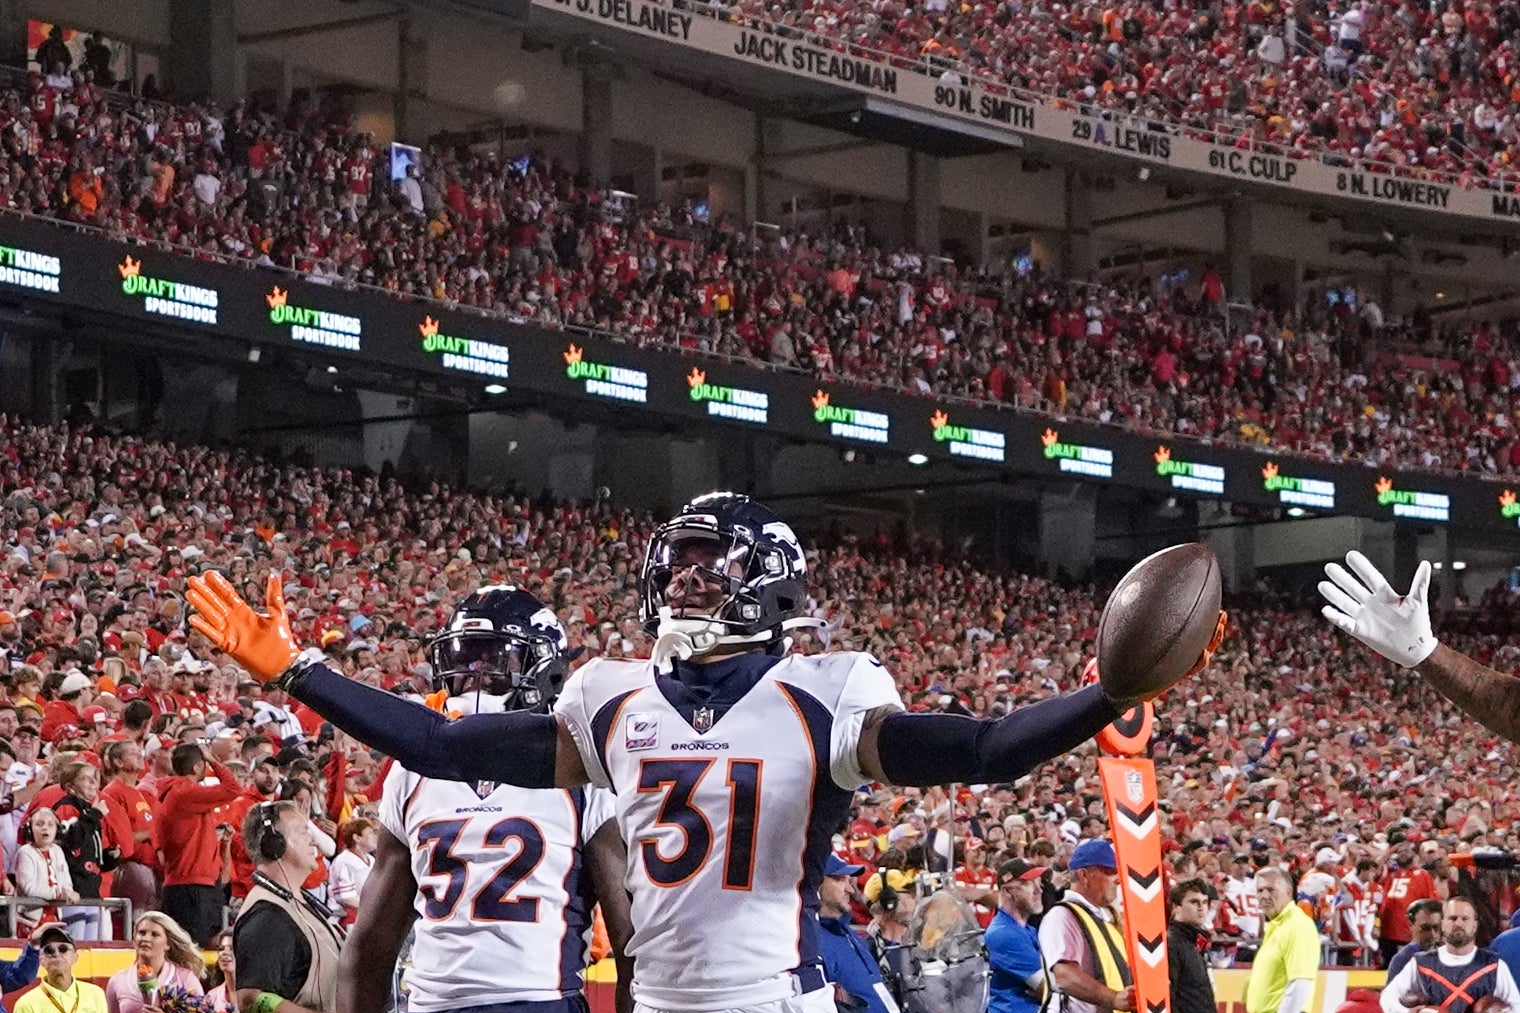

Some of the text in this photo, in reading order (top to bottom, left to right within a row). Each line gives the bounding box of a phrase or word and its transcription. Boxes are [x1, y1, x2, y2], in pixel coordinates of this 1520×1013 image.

[599, 0, 692, 40] DELANEY
[734, 31, 897, 94] JACK STEADMAN
[935, 86, 1035, 129] 90 N. SMITH
[1114, 127, 1171, 159] LEWIS
[1209, 150, 1297, 182] 61 C. CULP
[1350, 174, 1368, 195] N.
[1373, 177, 1450, 207] LOWERY
[123, 273, 218, 308] DRAFTKINGS
[145, 297, 217, 324] SPORTSBOOK
[271, 304, 361, 334] DRAFTKINGS
[291, 325, 360, 351] SPORTSBOOK
[423, 333, 509, 362] DRAFTKINGS
[443, 353, 509, 378] SPORTSBOOK
[567, 360, 648, 387] DRAFTKINGS
[586, 379, 647, 402] SPORTSBOOK
[690, 383, 768, 409] DRAFTKINGS
[708, 401, 768, 423] SPORTSBOOK
[815, 405, 889, 429] DRAFTKINGS
[831, 422, 888, 443] SPORTSBOOK
[934, 425, 1006, 448] DRAFTKINGS
[950, 440, 1005, 462] SPORTSBOOK
[1044, 442, 1114, 465] DRAFTKINGS
[1060, 458, 1113, 477] SPORTSBOOK
[1157, 460, 1225, 481] DRAFTKINGS
[1171, 474, 1224, 494] SPORTSBOOK
[1265, 475, 1335, 496] DRAFTKINGS
[1279, 490, 1334, 508] SPORTSBOOK
[1378, 490, 1450, 508] DRAFTKINGS
[1393, 503, 1449, 521] SPORTSBOOK
[671, 742, 730, 751] BRONCOS
[455, 806, 503, 814] BRONCOS
[637, 758, 764, 891] 31
[417, 817, 547, 923] 32
[1388, 878, 1411, 898] 15
